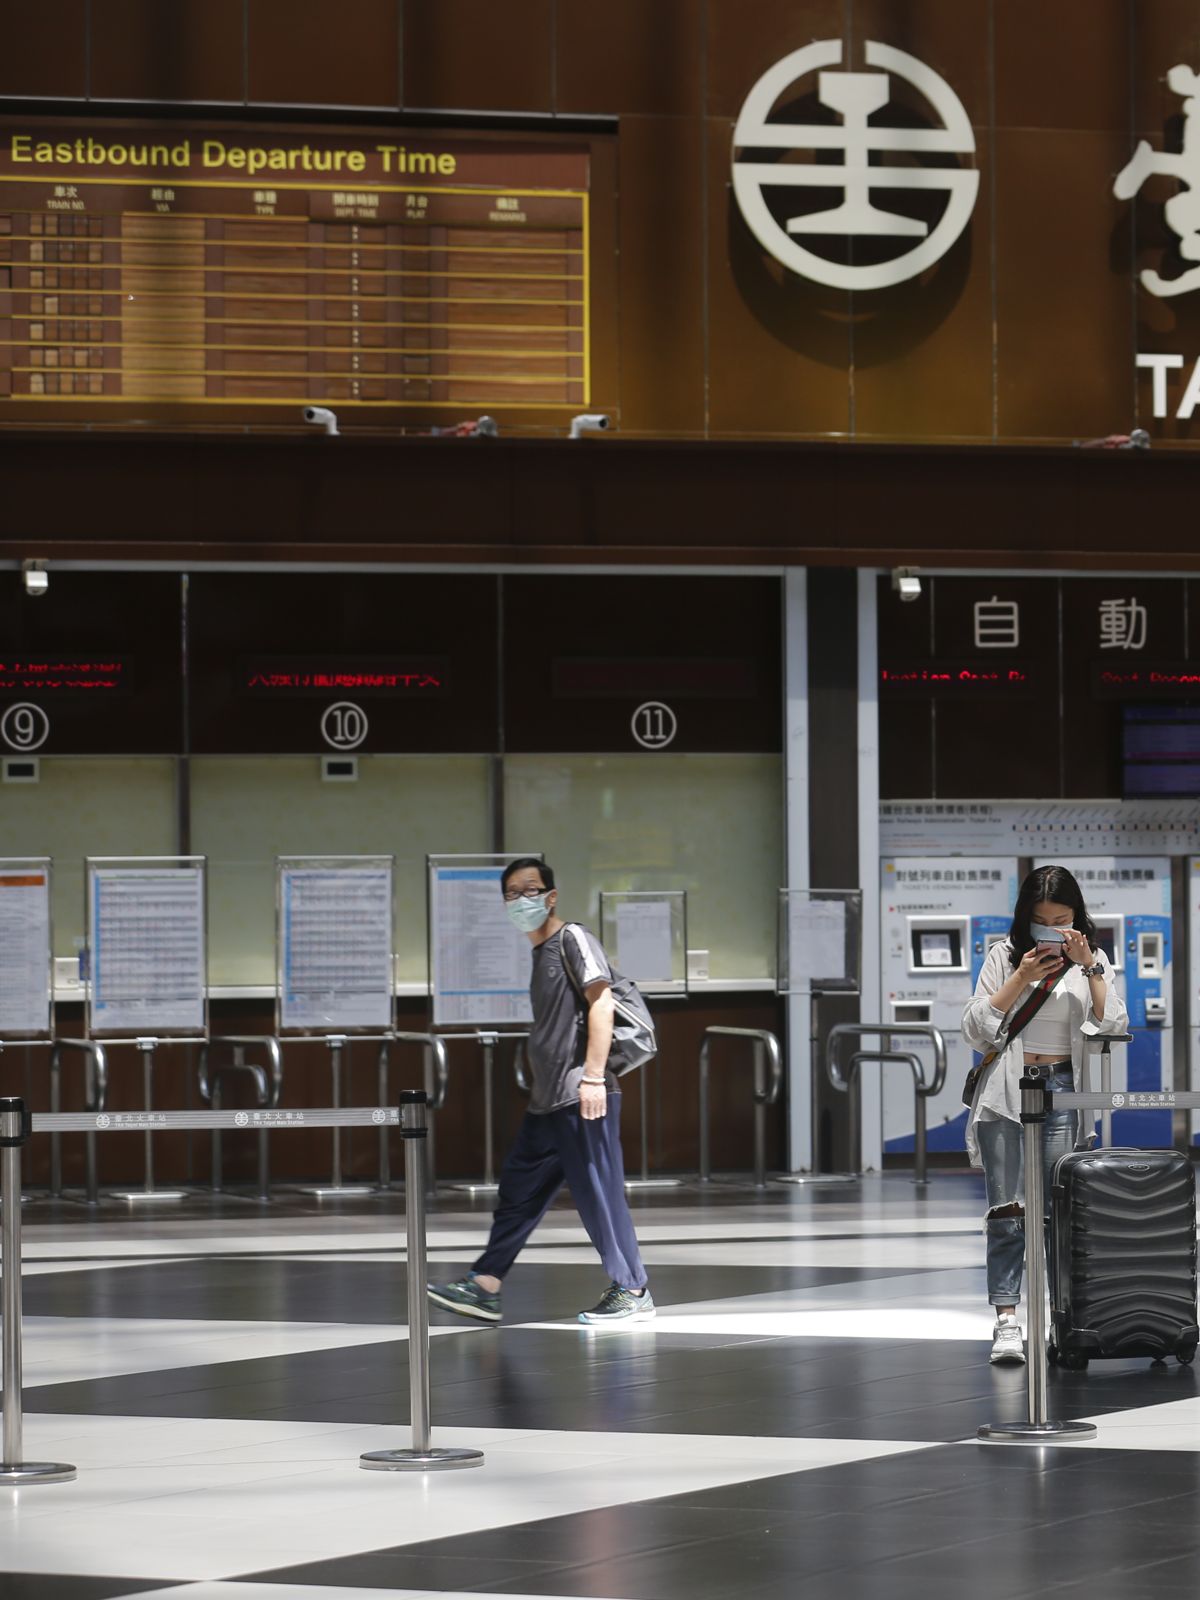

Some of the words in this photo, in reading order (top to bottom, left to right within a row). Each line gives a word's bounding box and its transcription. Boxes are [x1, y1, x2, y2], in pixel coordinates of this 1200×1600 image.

[11, 136, 190, 167] Eastbound
[203, 141, 367, 176] Departure
[377, 145, 457, 175] Time
[47, 199, 71, 210] TRAIN
[14, 709, 34, 744] 9
[332, 710, 361, 741] 10
[642, 709, 667, 740] 11
[1129, 1094, 1176, 1102] 臺北火車站
